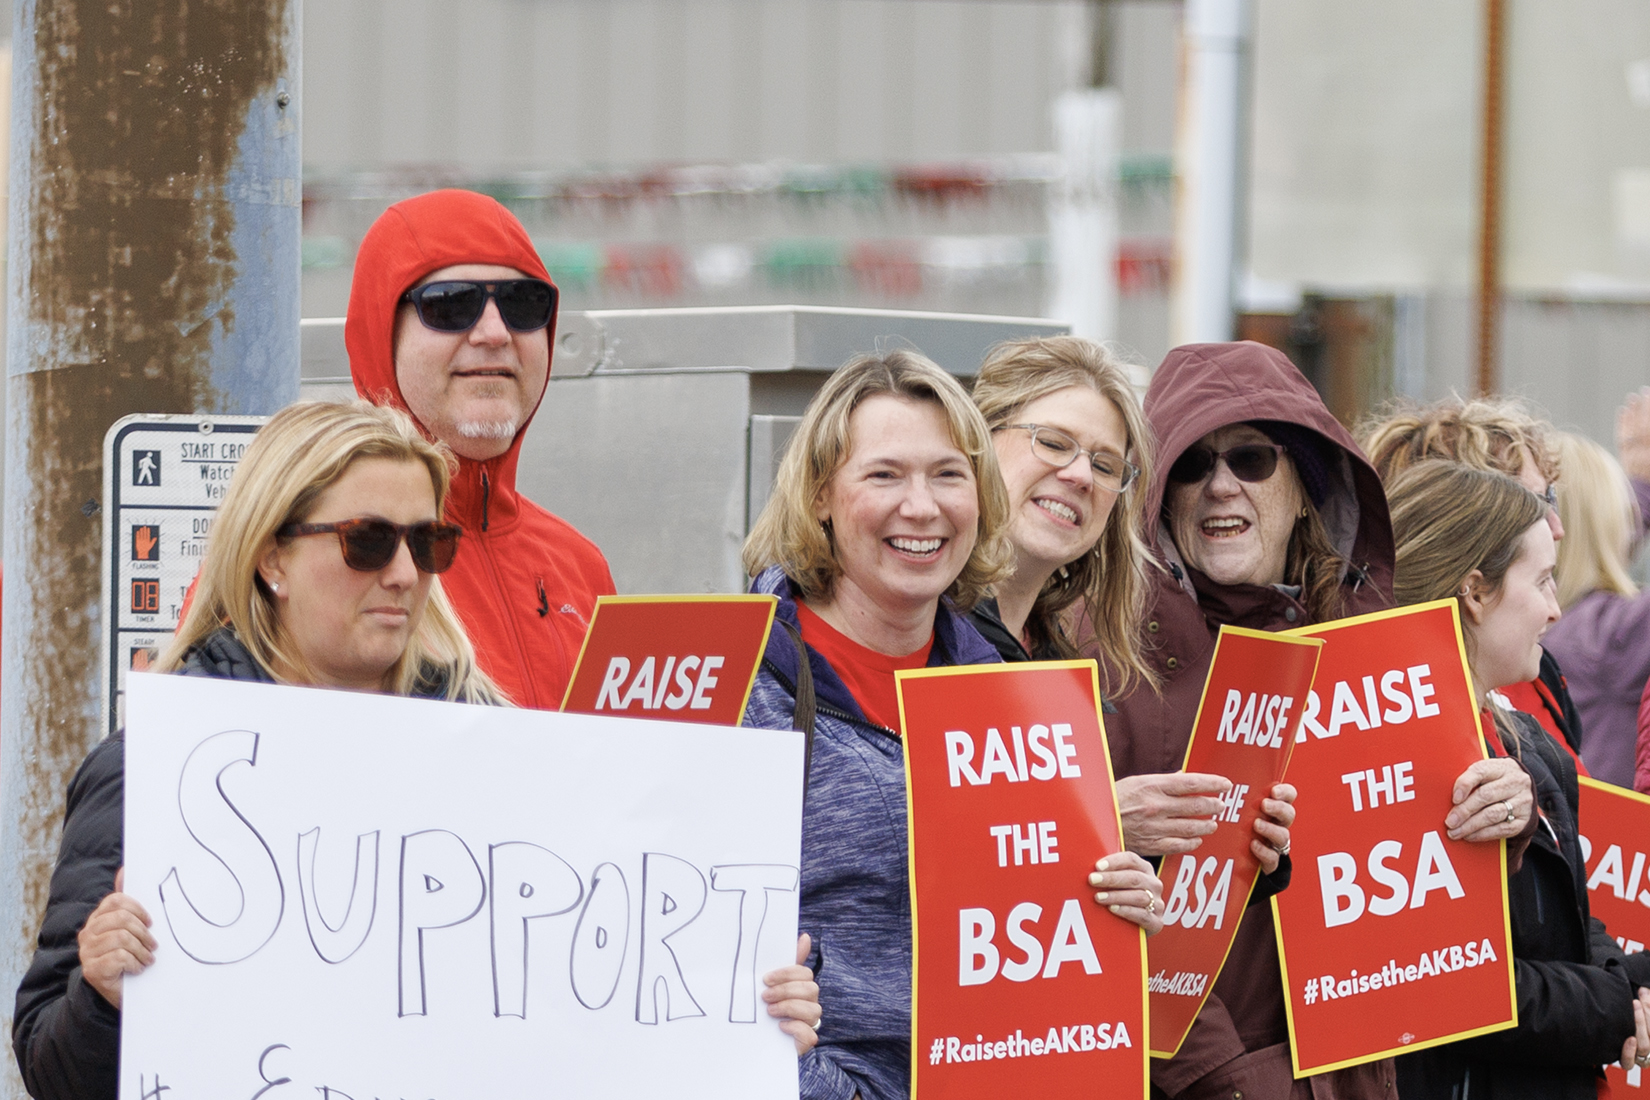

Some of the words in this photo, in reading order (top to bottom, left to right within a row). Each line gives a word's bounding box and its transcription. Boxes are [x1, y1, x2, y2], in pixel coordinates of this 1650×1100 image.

[181, 442, 216, 459] START
[192, 517, 213, 534] DO
[135, 615, 156, 623] TIMER
[595, 655, 725, 710] RAISE
[1294, 664, 1441, 744] RAISE
[1216, 689, 1293, 749] RAISE
[944, 723, 1082, 788] RAISE
[1212, 784, 1250, 824] HE
[1341, 761, 1416, 813] THE
[990, 821, 1060, 868] THE
[159, 729, 800, 1025] SUPPORT
[1162, 855, 1235, 931] BSA
[1316, 830, 1466, 929] BSA
[958, 898, 1103, 987] BSA
[1304, 938, 1498, 1006] #RaisetheAKBSA
[929, 1021, 1133, 1066] #RaisetheAKBSA
